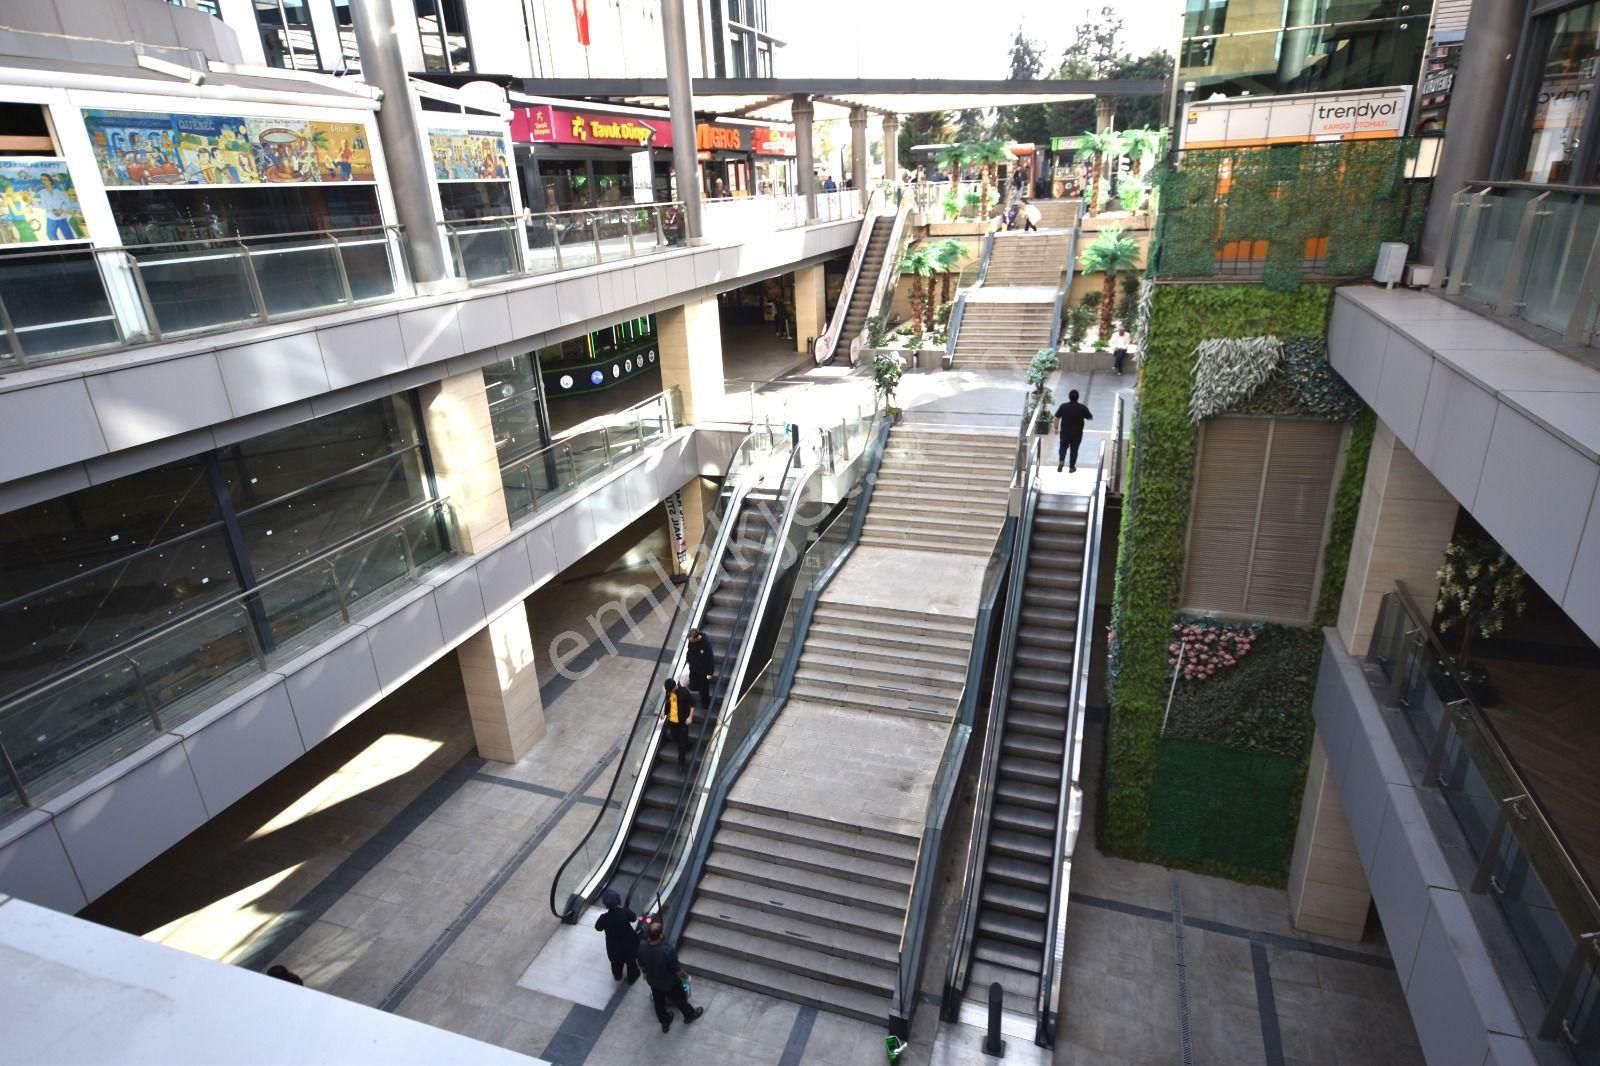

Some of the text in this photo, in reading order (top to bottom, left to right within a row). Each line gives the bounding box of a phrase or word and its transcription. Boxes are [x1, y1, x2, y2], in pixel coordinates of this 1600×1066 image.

[1318, 100, 1397, 119] trendyol
[590, 121, 621, 138] Tavuk
[1323, 122, 1351, 130] KARGO
